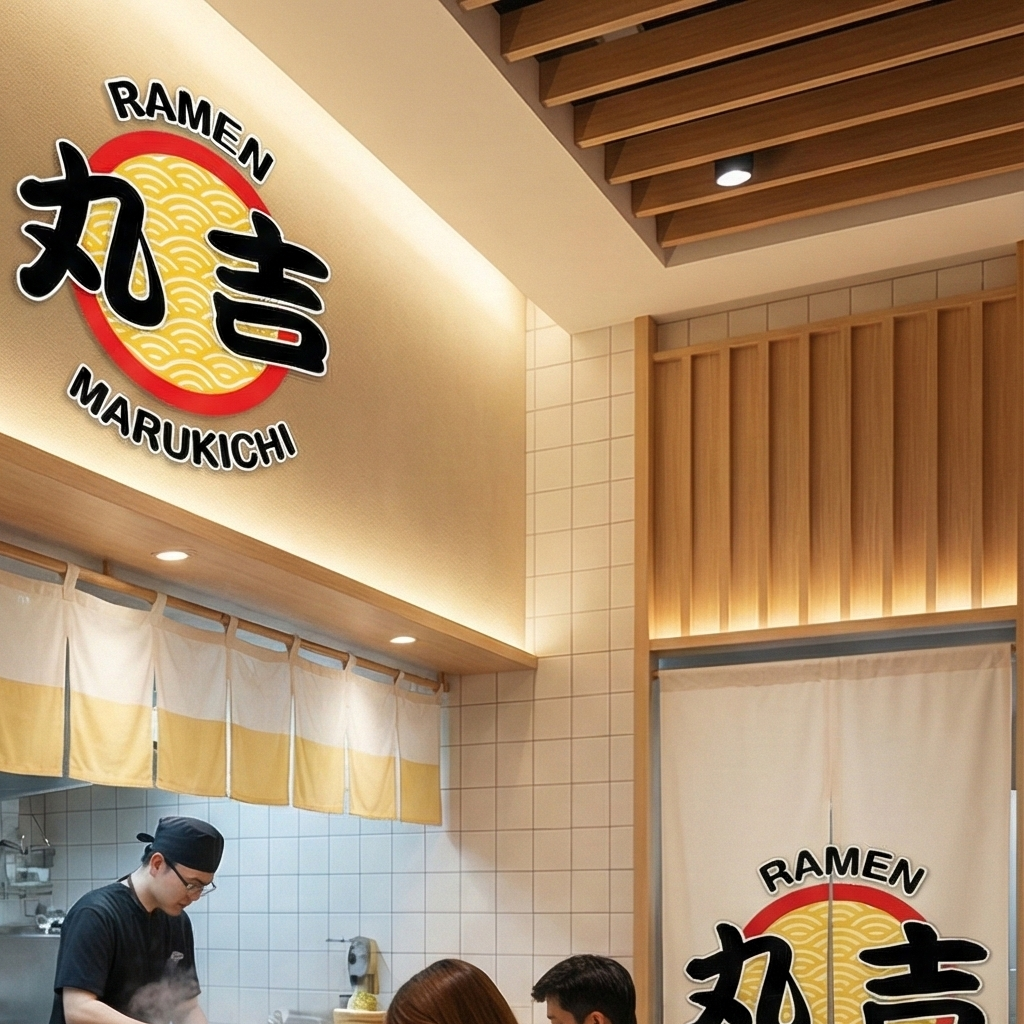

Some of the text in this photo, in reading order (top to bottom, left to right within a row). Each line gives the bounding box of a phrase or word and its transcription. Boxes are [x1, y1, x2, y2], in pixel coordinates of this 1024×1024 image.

[107, 80, 274, 182] RAMEN
[19, 141, 329, 374] 丸吉
[69, 366, 296, 469] MARUKICHI
[759, 846, 925, 895] RAMEN
